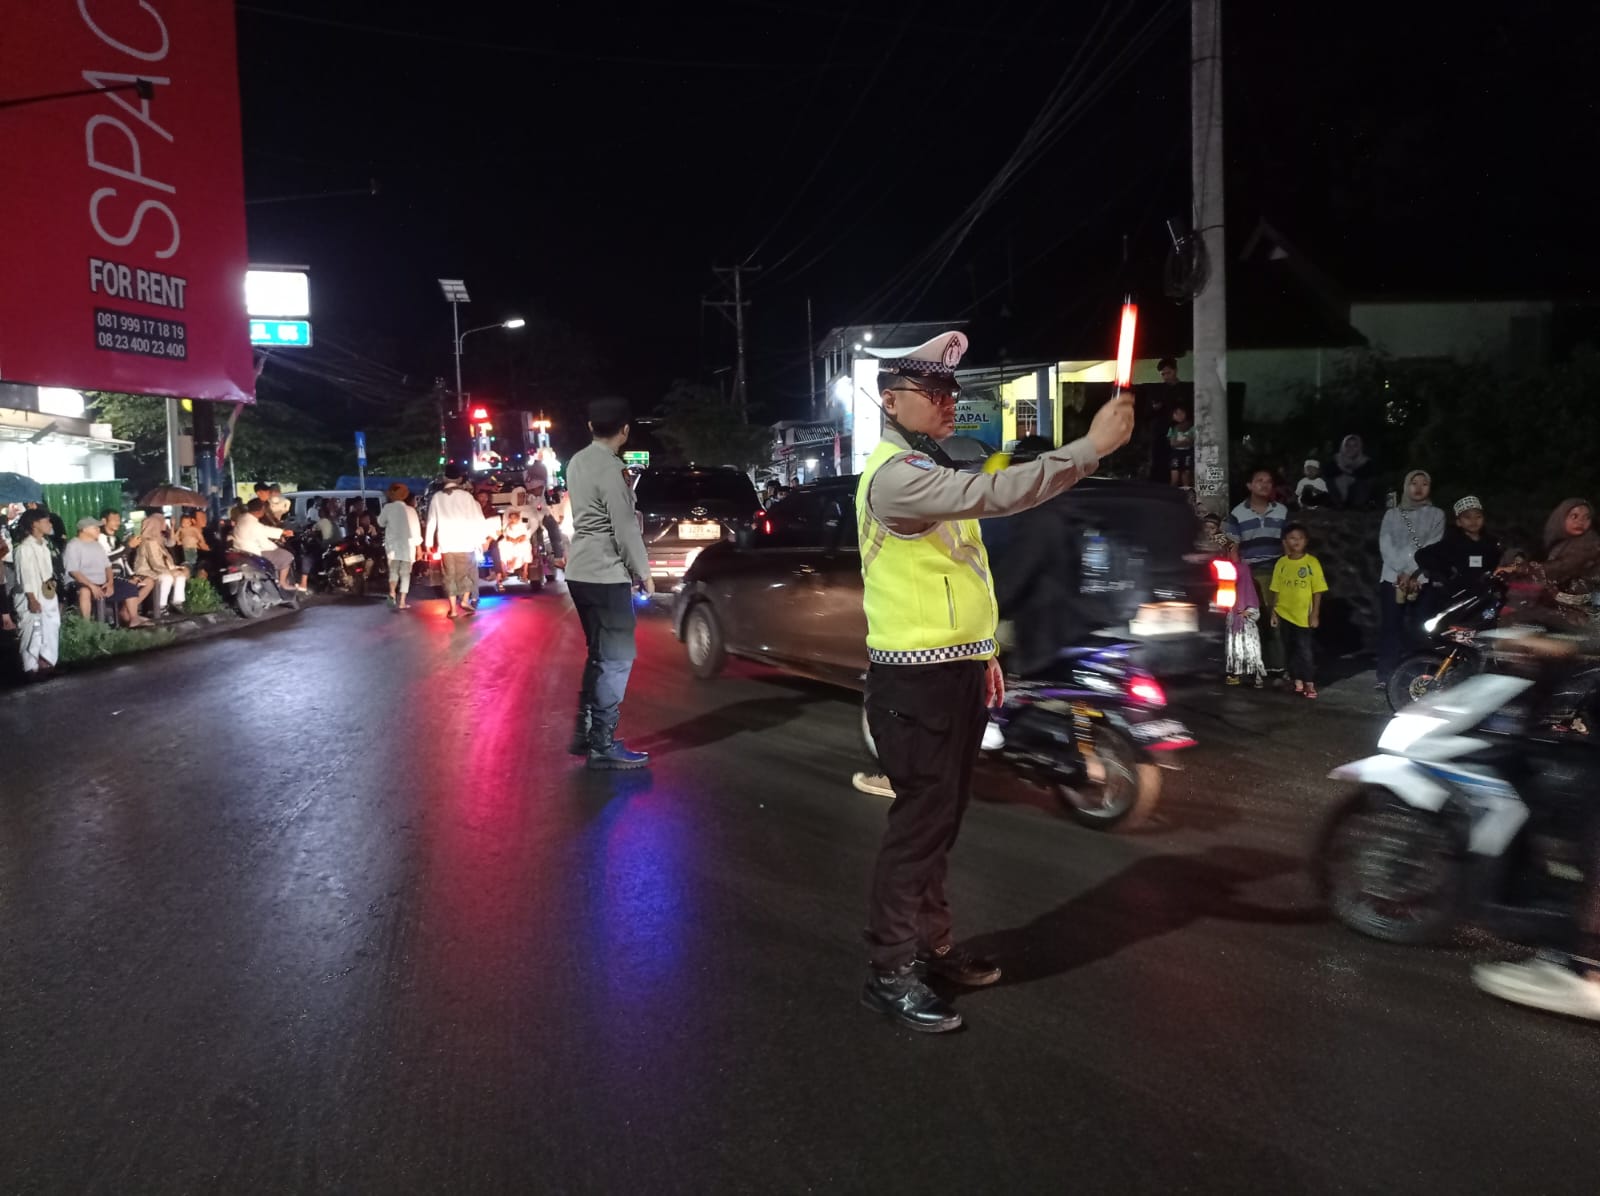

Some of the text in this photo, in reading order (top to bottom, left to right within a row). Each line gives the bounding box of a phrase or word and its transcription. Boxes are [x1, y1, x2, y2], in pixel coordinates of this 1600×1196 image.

[89, 258, 187, 310] FOR RENT
[97, 312, 184, 340] 081 999 17 18 19
[98, 331, 185, 358] 08 23 400 23 400
